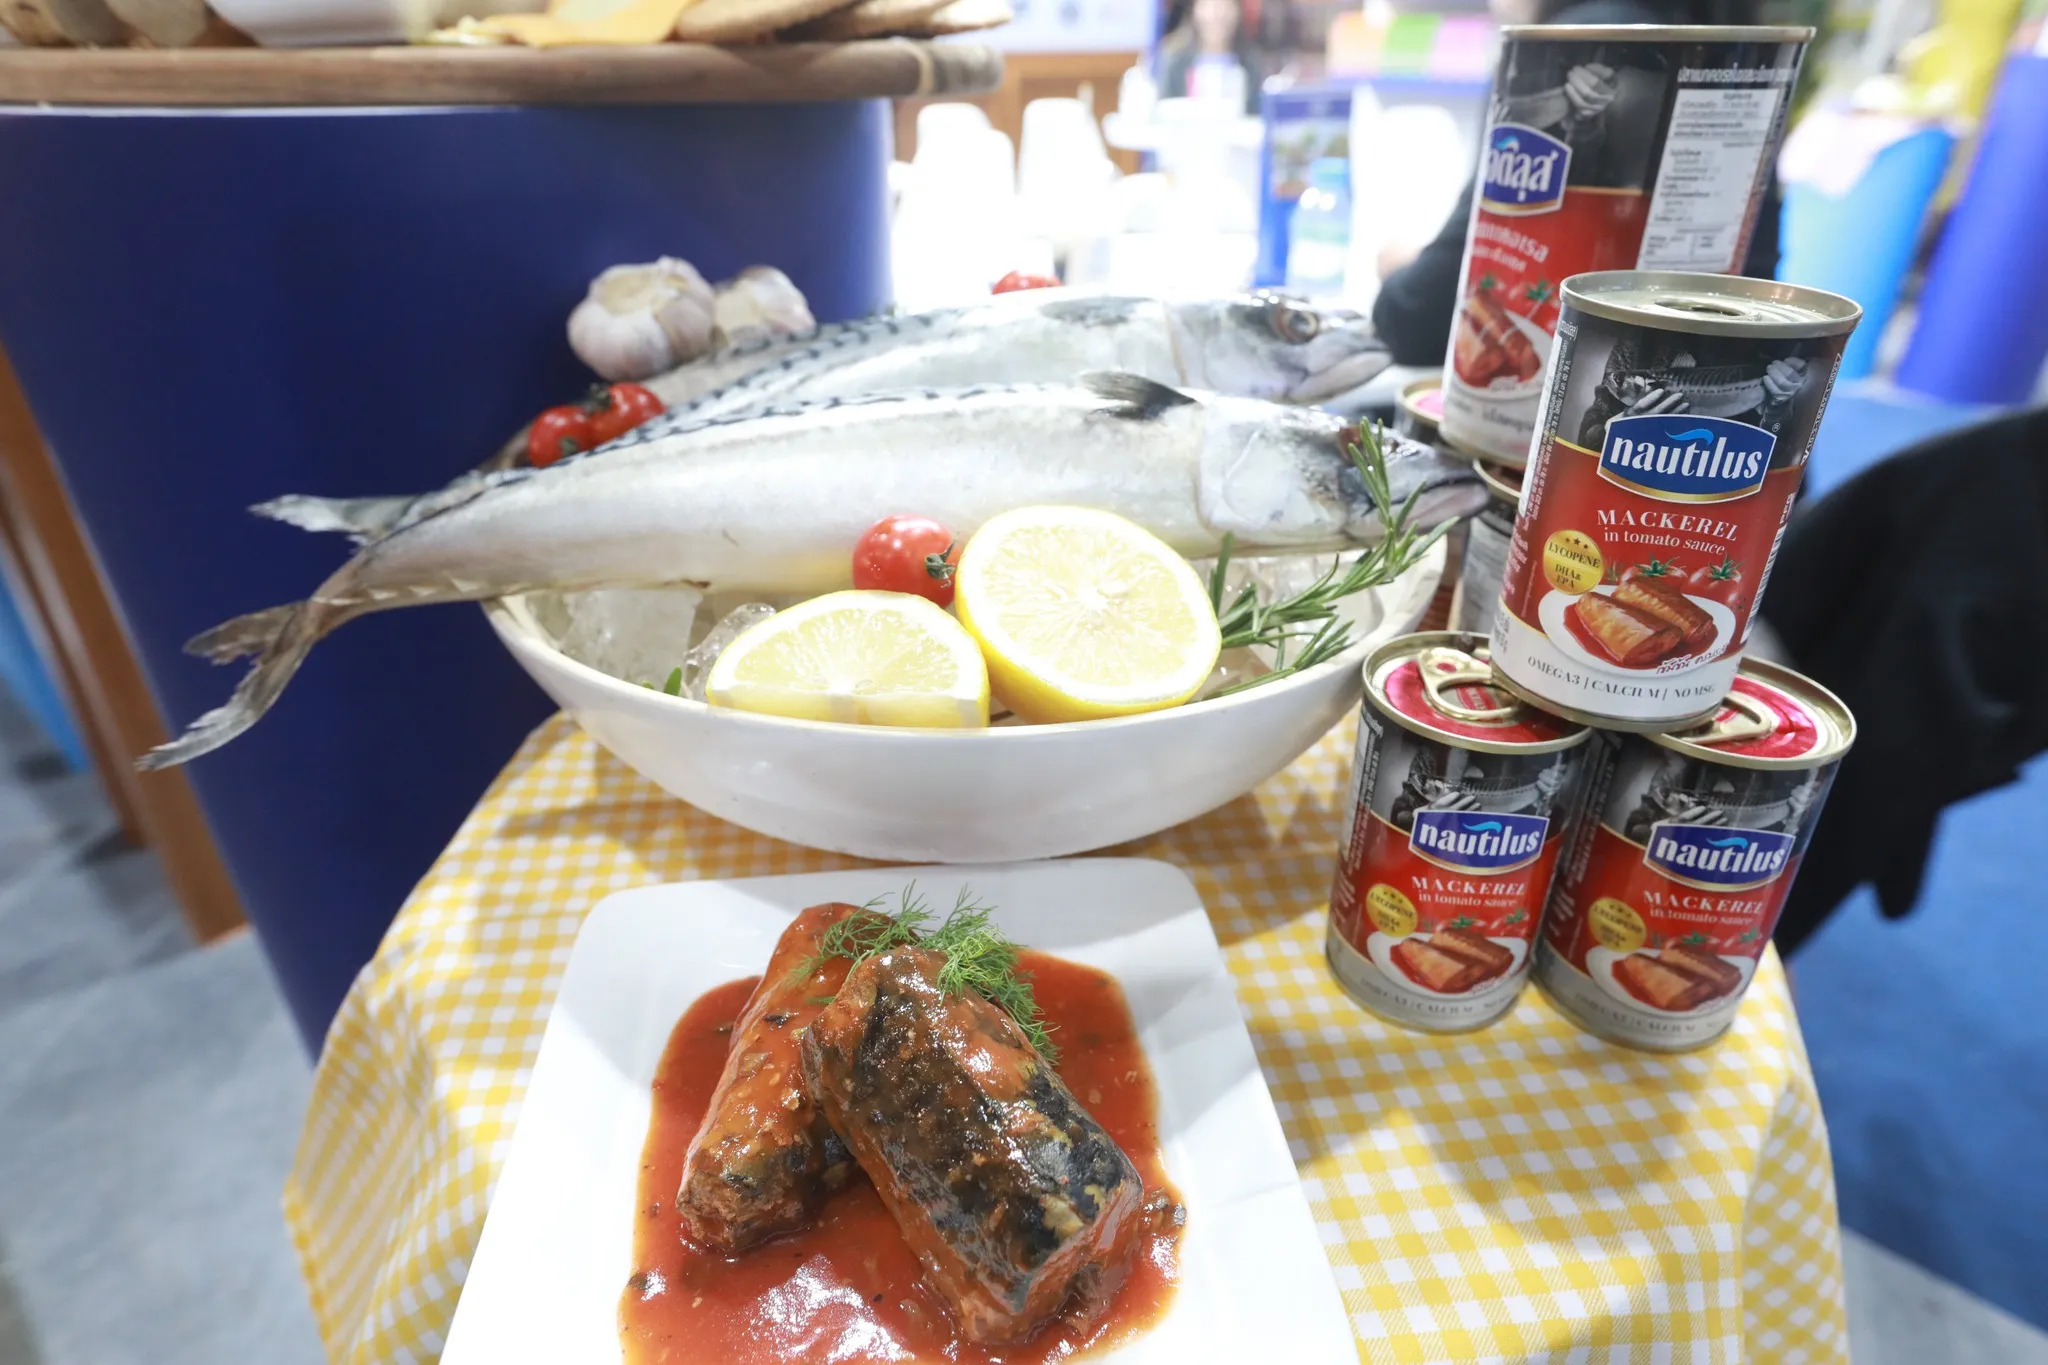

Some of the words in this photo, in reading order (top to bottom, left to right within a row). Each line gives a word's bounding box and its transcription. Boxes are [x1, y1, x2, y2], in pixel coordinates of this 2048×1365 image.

[1610, 437, 1762, 479] nautilus
[1597, 509, 1738, 542] MACKEREL
[1604, 527, 1619, 542] in
[1624, 530, 1680, 547] tomato
[1683, 537, 1725, 556] sauce
[1548, 541, 1601, 569] LYCOPENE
[1557, 574, 1575, 589] EPA
[1591, 680, 1661, 699] CALCIUM
[1675, 688, 1692, 698] NO
[1419, 826, 1540, 856] nautilus
[1656, 837, 1785, 873] nautilus
[1412, 876, 1527, 896] MACKEREL
[1418, 889, 1431, 902] in
[1435, 893, 1481, 906] tomato
[1643, 890, 1763, 915] MACKEREL
[1650, 906, 1663, 917] in
[1668, 909, 1717, 924] tomato
